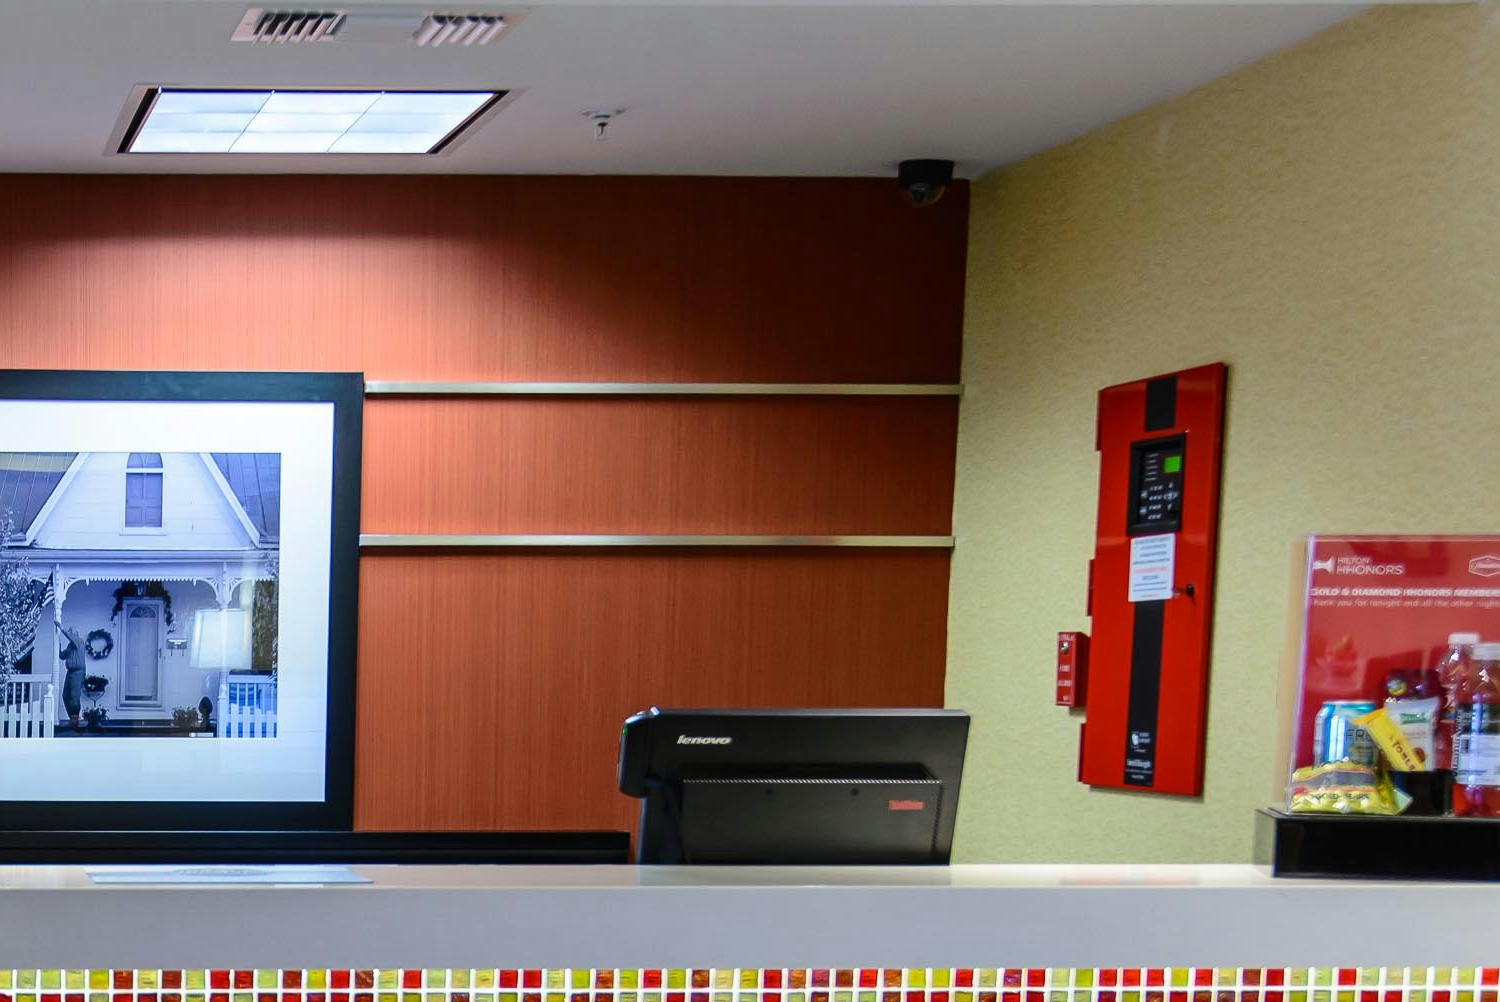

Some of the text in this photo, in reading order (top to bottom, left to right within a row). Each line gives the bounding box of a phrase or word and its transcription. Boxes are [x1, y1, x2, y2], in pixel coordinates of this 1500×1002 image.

[1336, 565, 1404, 575] HHONORS
[1351, 588, 1401, 597] DIAMOND
[676, 734, 733, 745] lenovo
